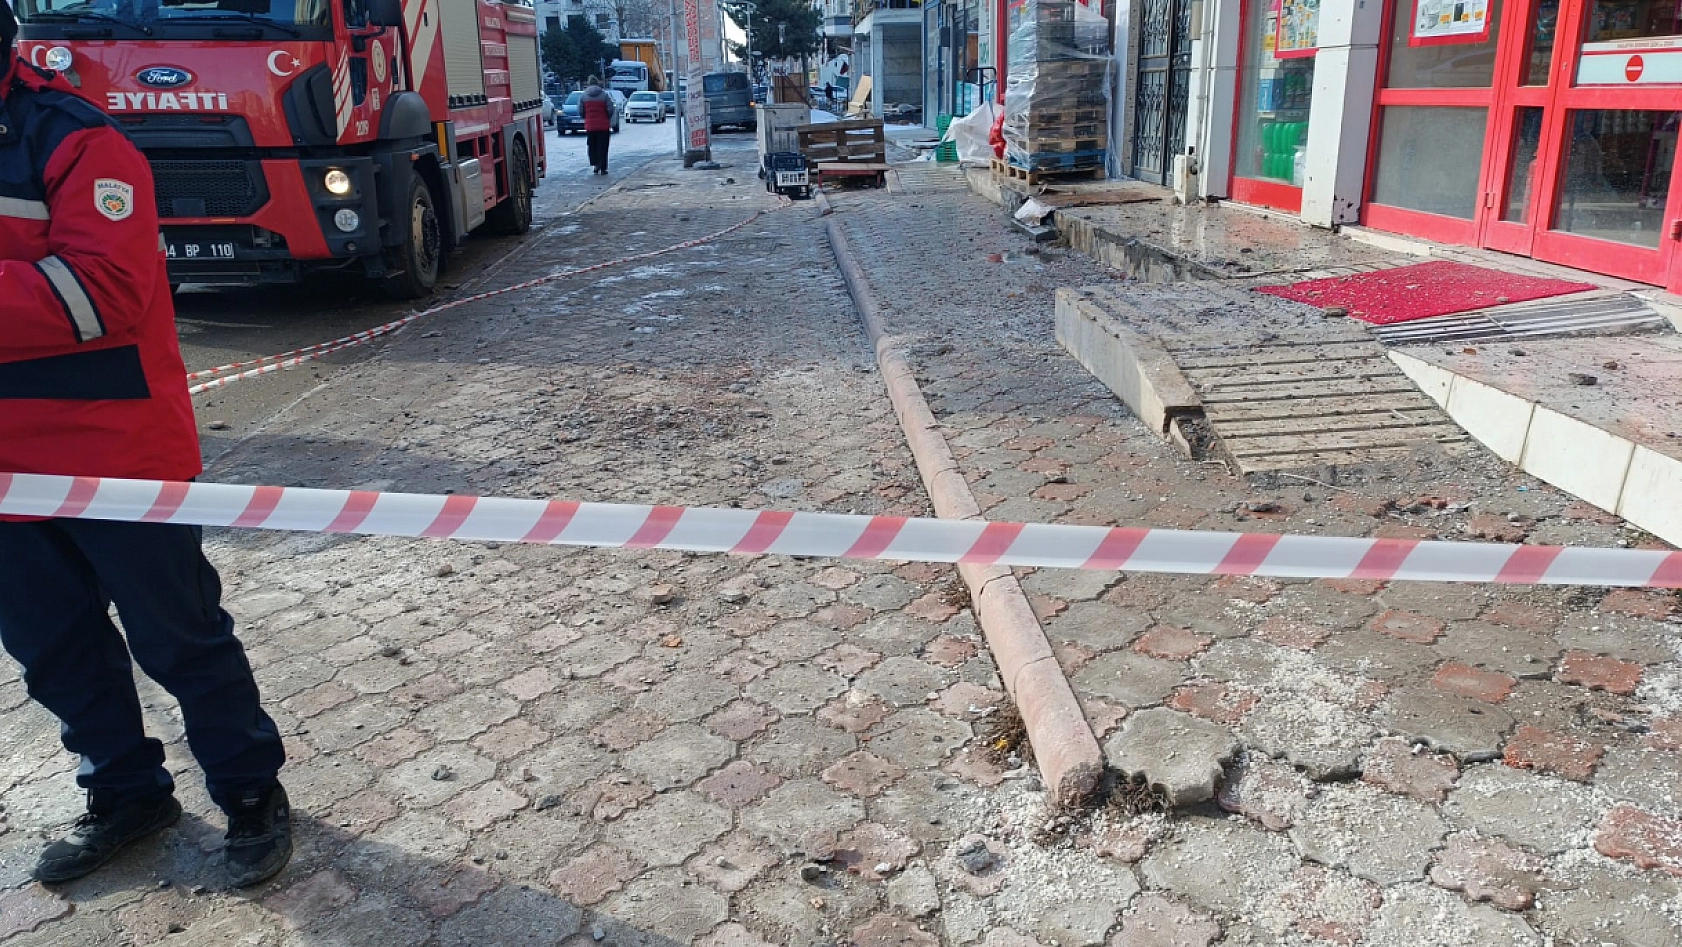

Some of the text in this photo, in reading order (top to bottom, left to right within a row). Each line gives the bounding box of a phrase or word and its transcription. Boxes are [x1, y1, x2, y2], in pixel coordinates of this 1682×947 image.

[147, 70, 178, 84] Ford
[97, 182, 130, 195] MALATYA
[185, 244, 200, 257] BP
[210, 243, 232, 256] 110
